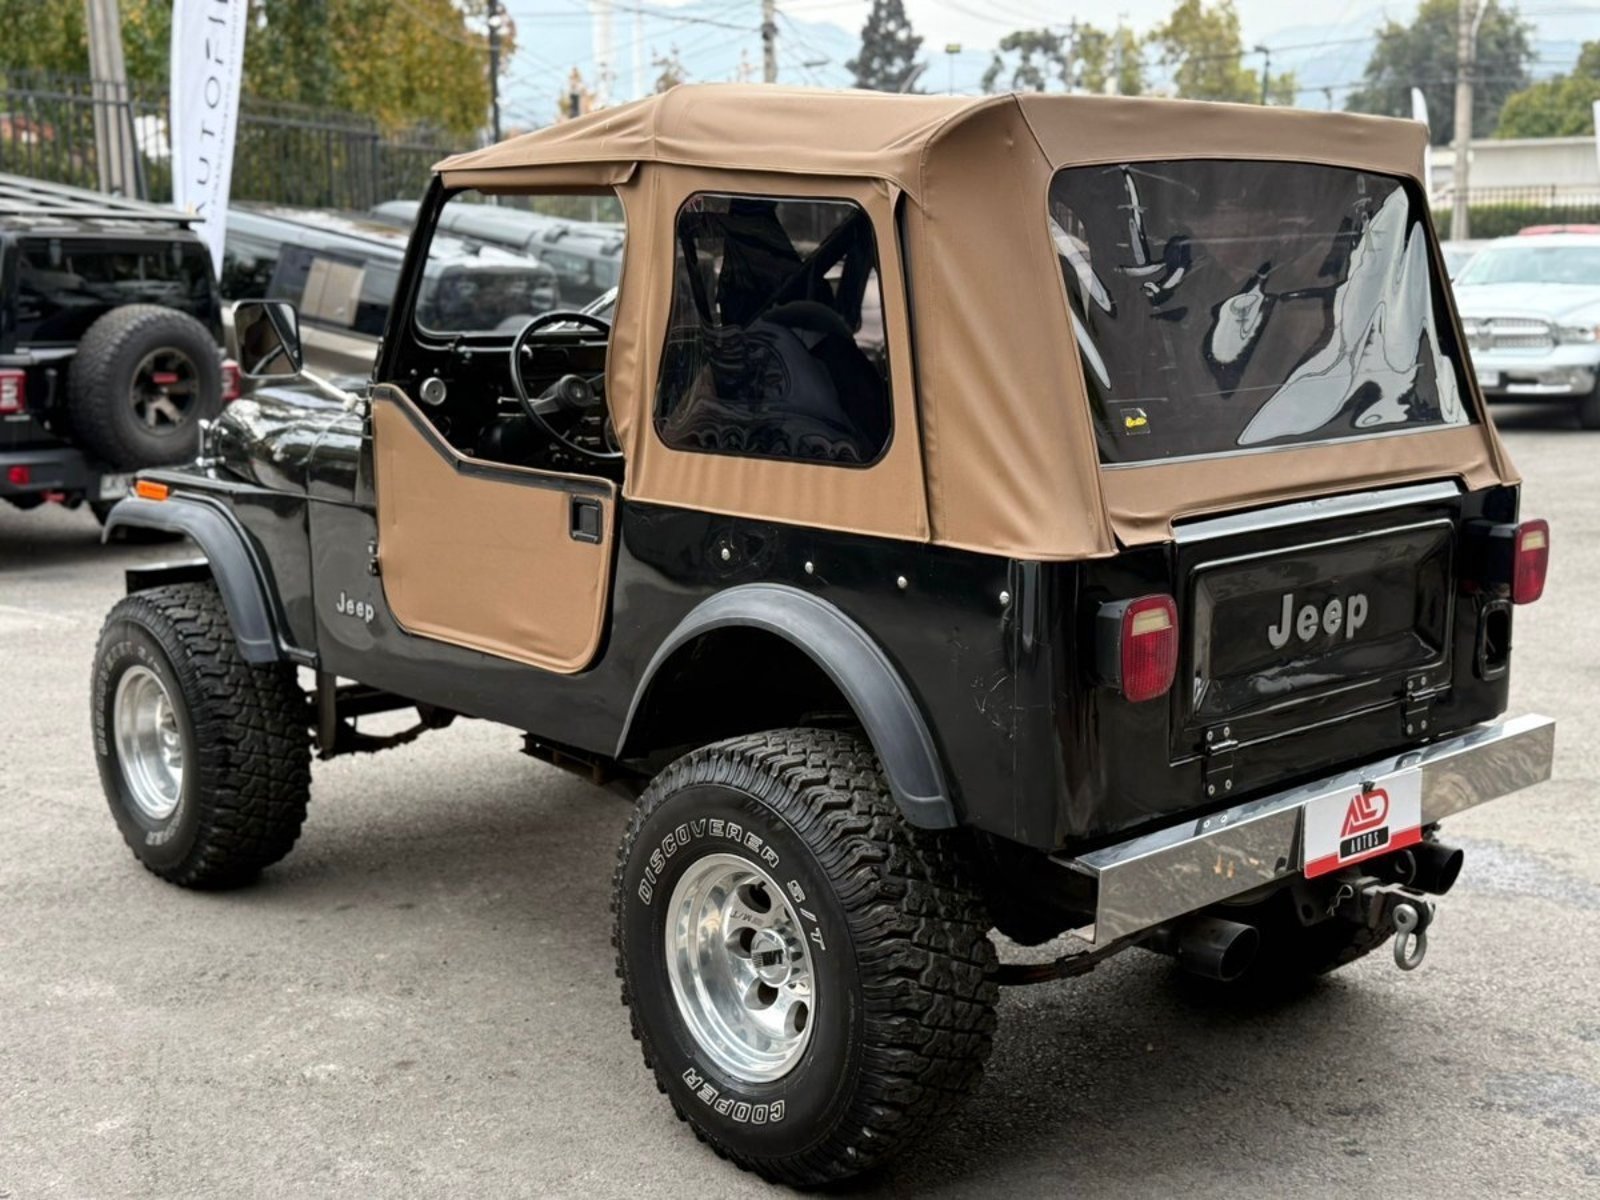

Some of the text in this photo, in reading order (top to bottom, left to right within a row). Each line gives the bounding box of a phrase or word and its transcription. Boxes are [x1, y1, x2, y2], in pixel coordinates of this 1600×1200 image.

[336, 591, 375, 623] Jeep
[1268, 593, 1369, 650] Jeep
[1350, 831, 1380, 853] AUTOS
[638, 818, 826, 951] DISCOVERER S/T
[682, 1067, 785, 1124] COOPER
